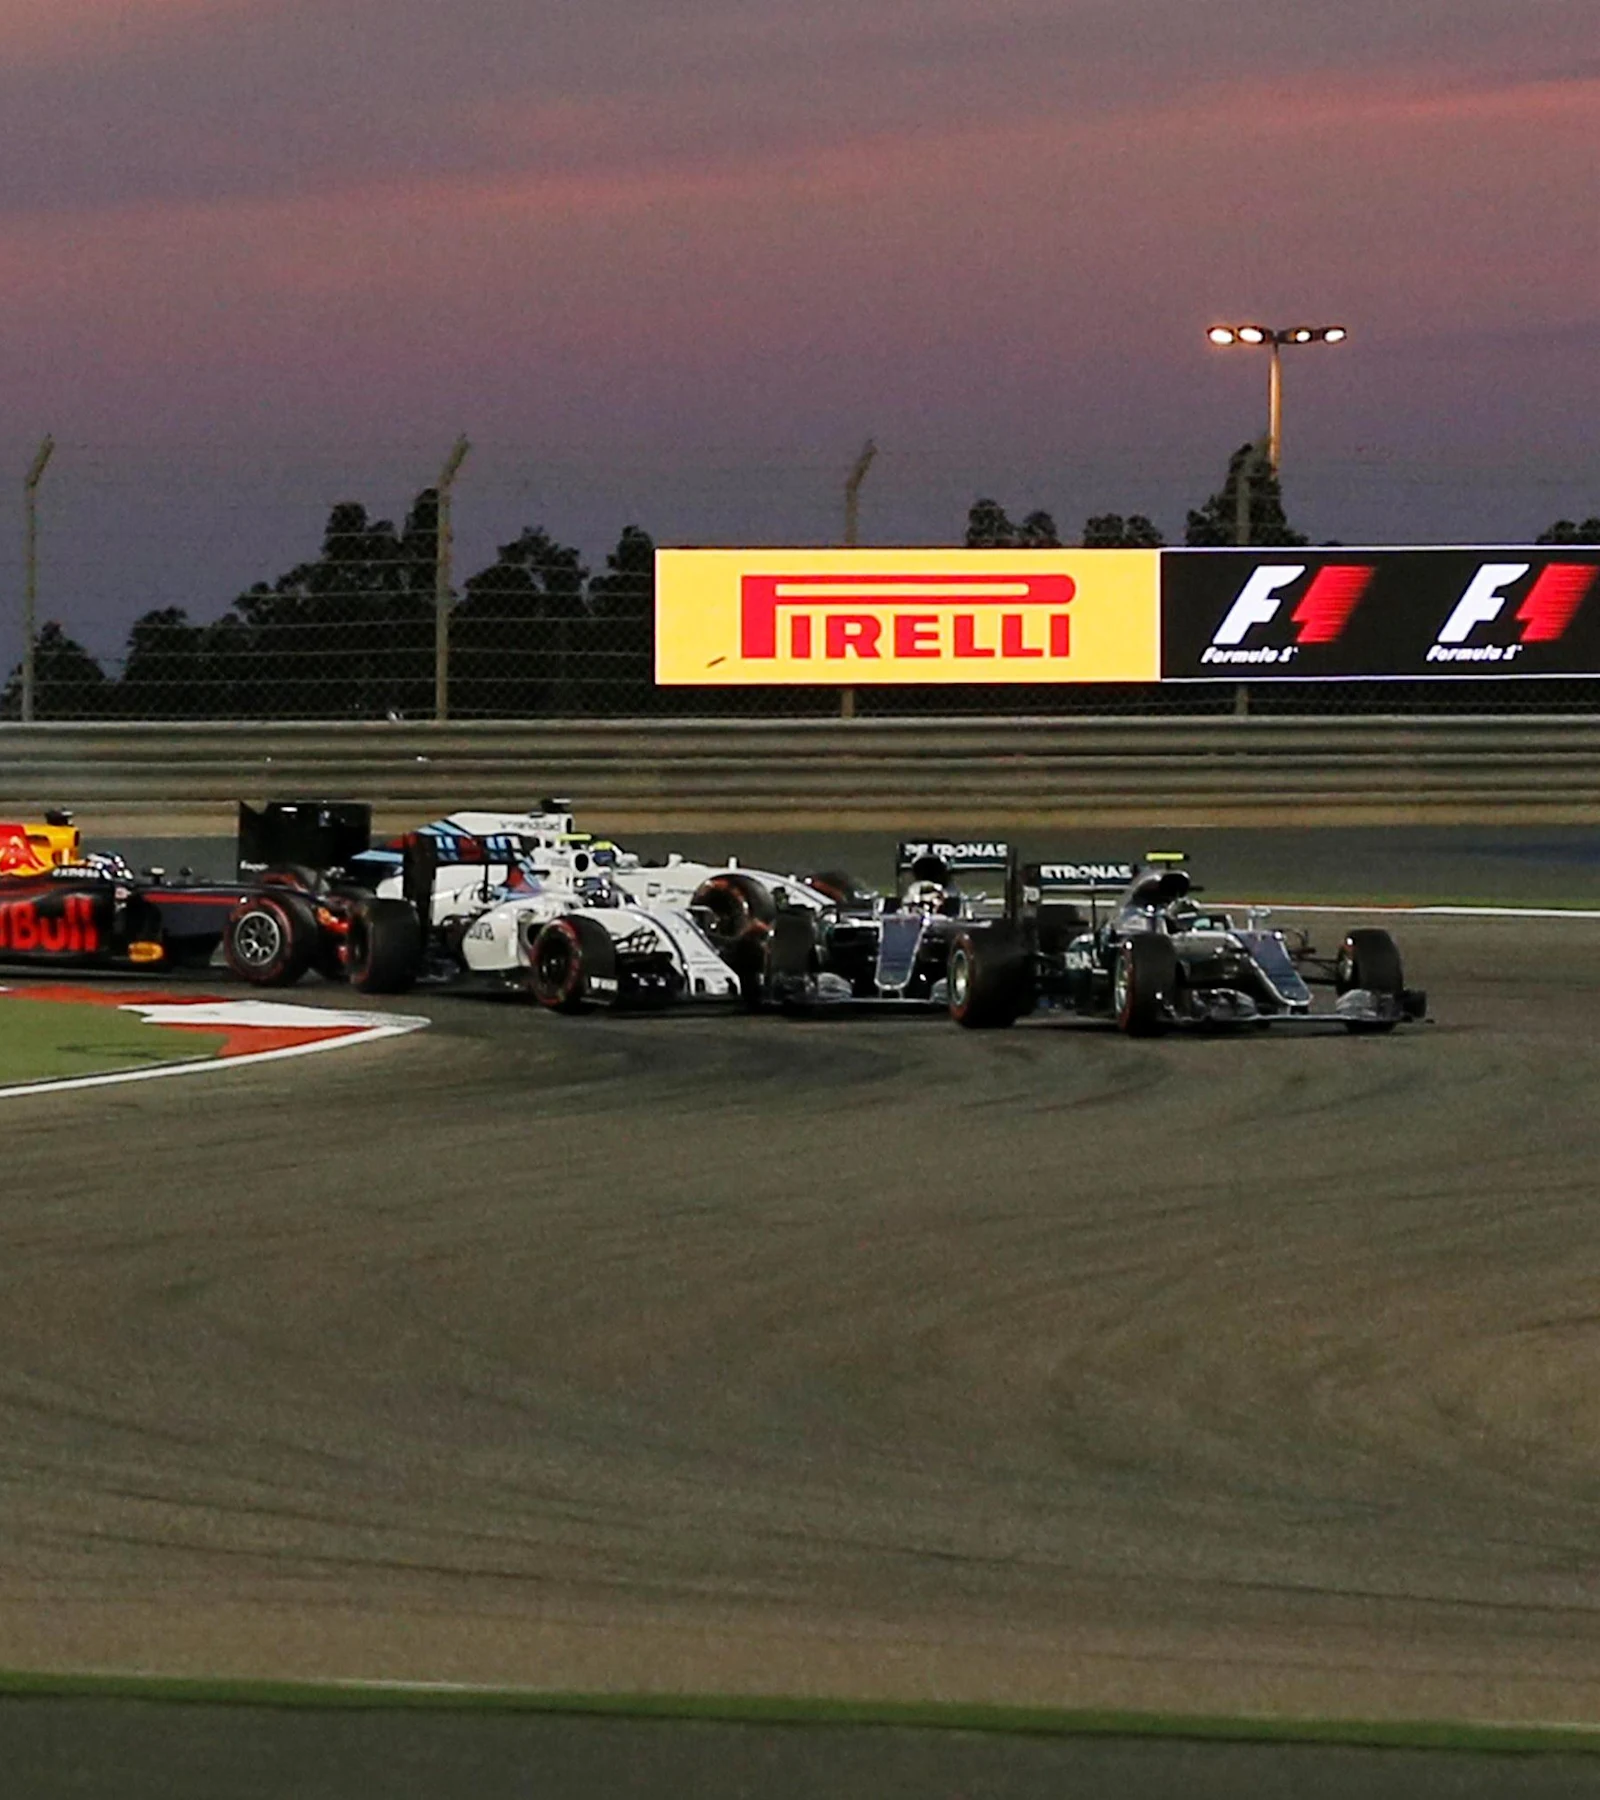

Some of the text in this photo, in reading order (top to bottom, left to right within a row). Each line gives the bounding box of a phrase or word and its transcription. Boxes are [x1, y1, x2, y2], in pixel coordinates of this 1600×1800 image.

[741, 574, 1076, 659] PIRELLI
[1212, 565, 1374, 645] F1
[1437, 563, 1600, 643] F1
[1200, 646, 1279, 664] Formula
[1426, 644, 1503, 662] Formula
[1039, 864, 1133, 880] ETRONAS
